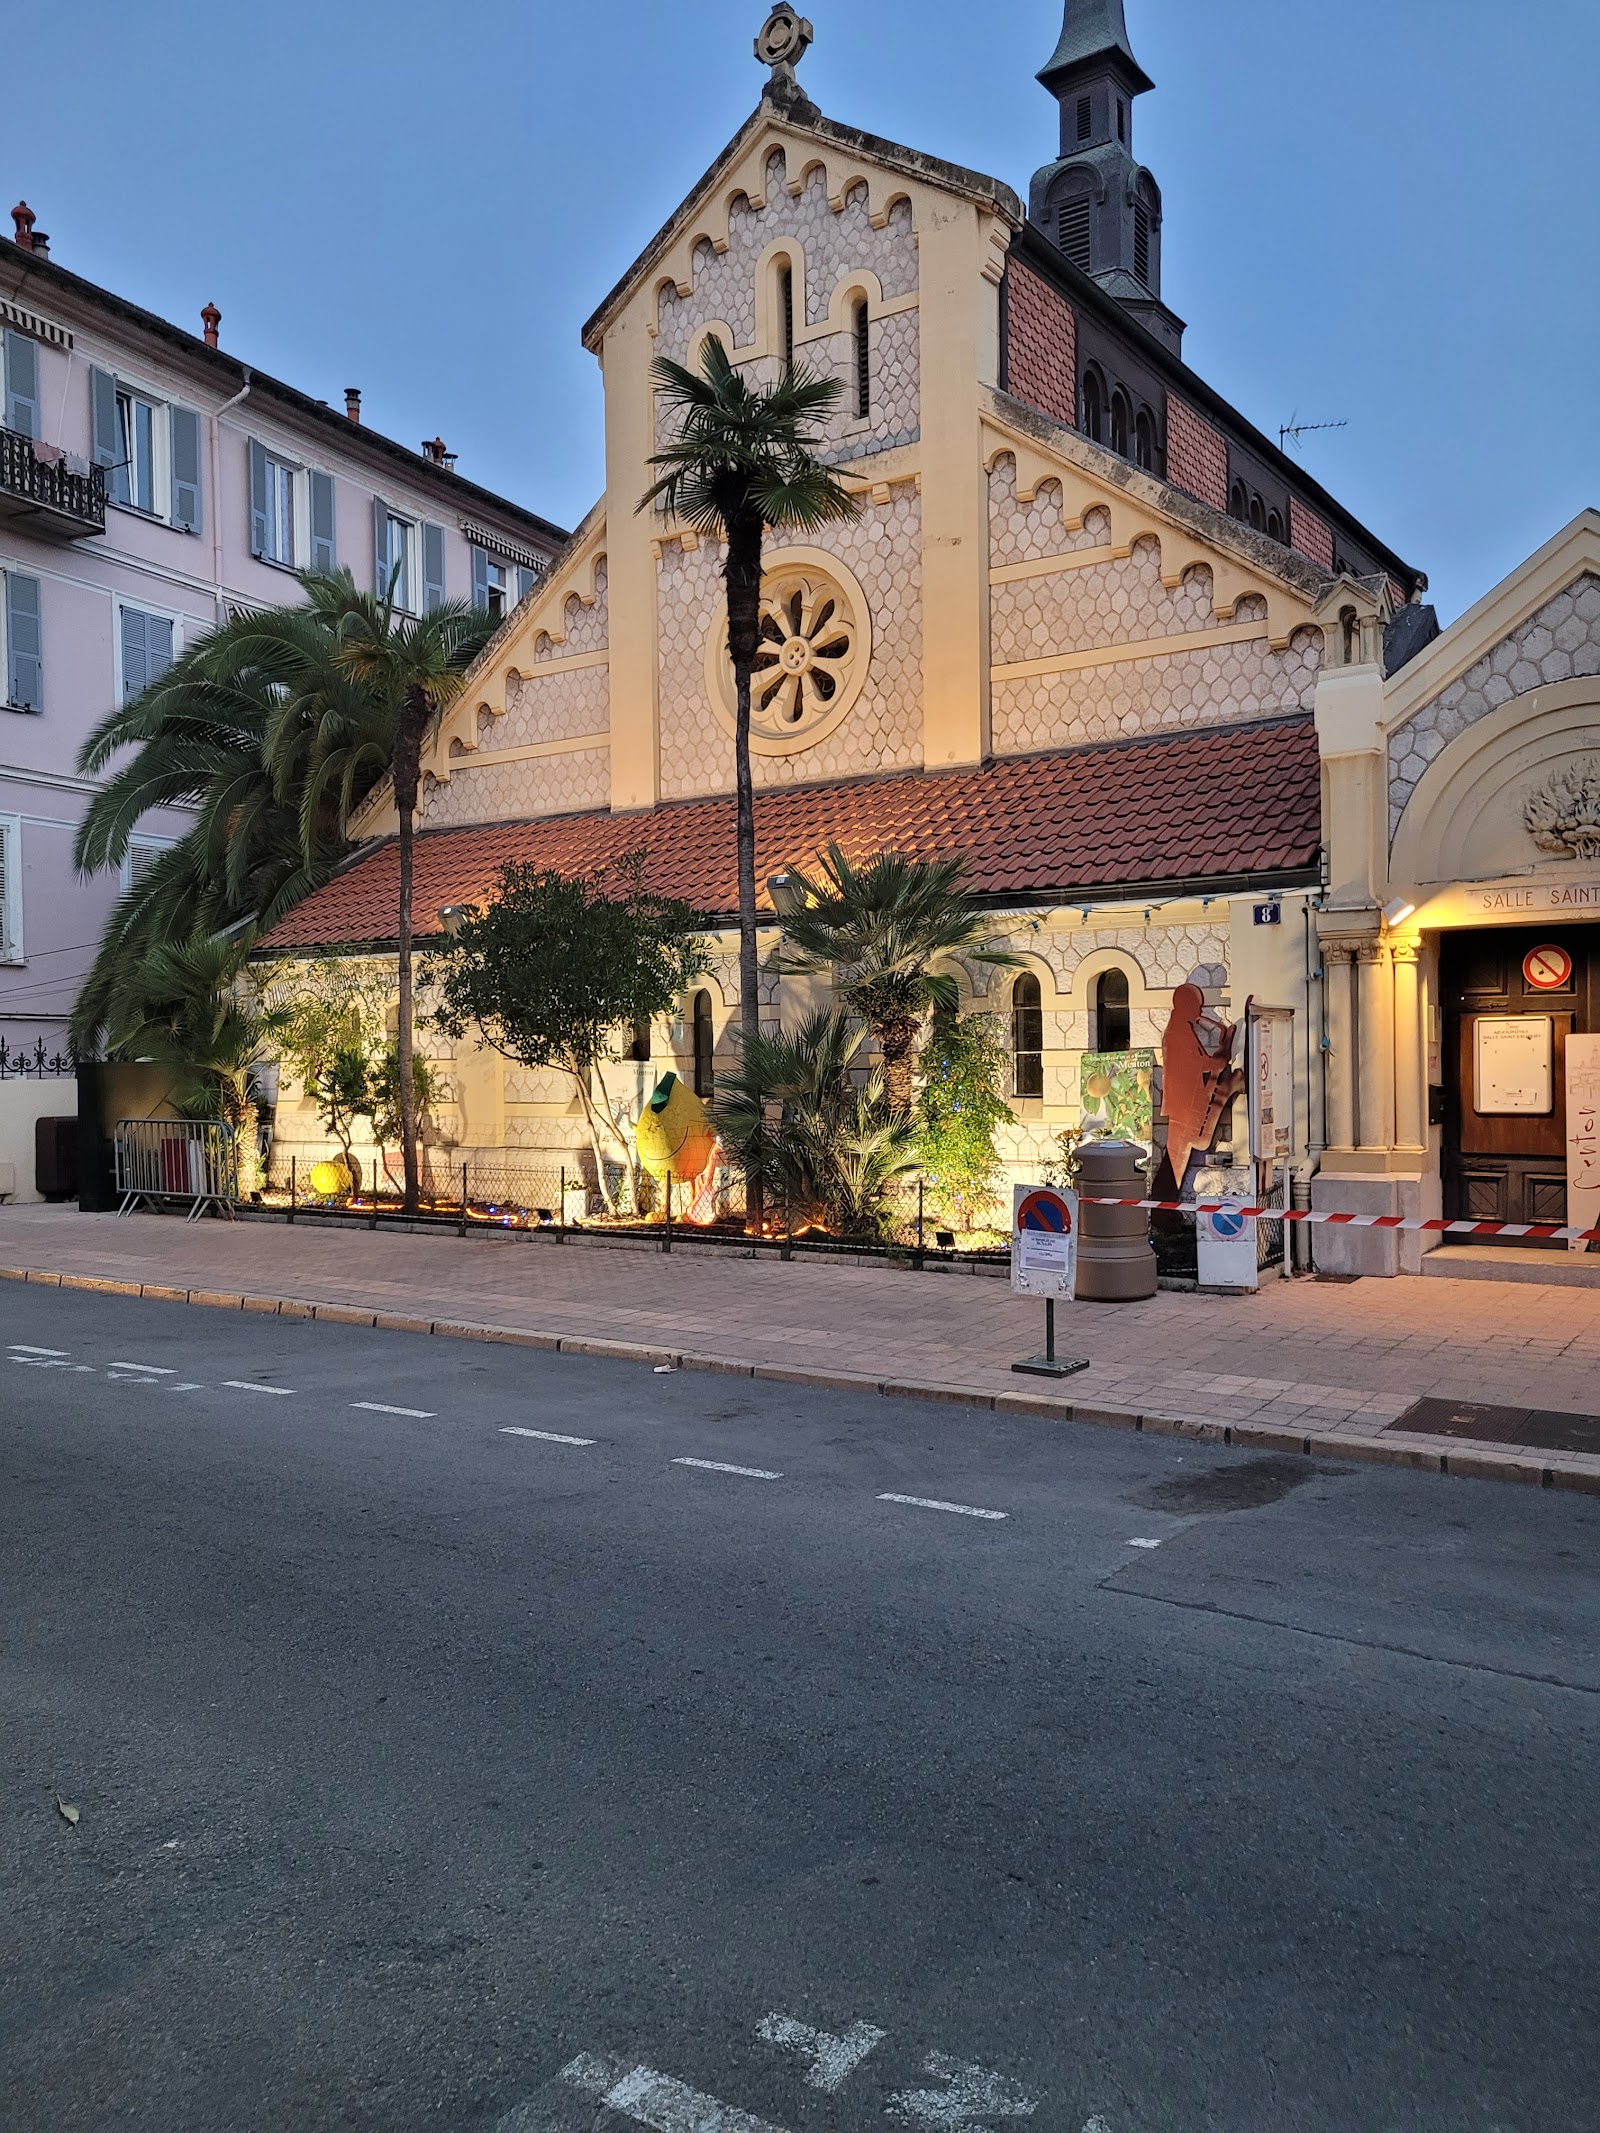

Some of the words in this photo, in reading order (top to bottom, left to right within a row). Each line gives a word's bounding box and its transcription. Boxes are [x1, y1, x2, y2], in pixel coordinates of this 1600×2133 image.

[1482, 891, 1534, 909] SALLE
[1550, 887, 1600, 905] SAINT
[1261, 906, 1272, 923] 8
